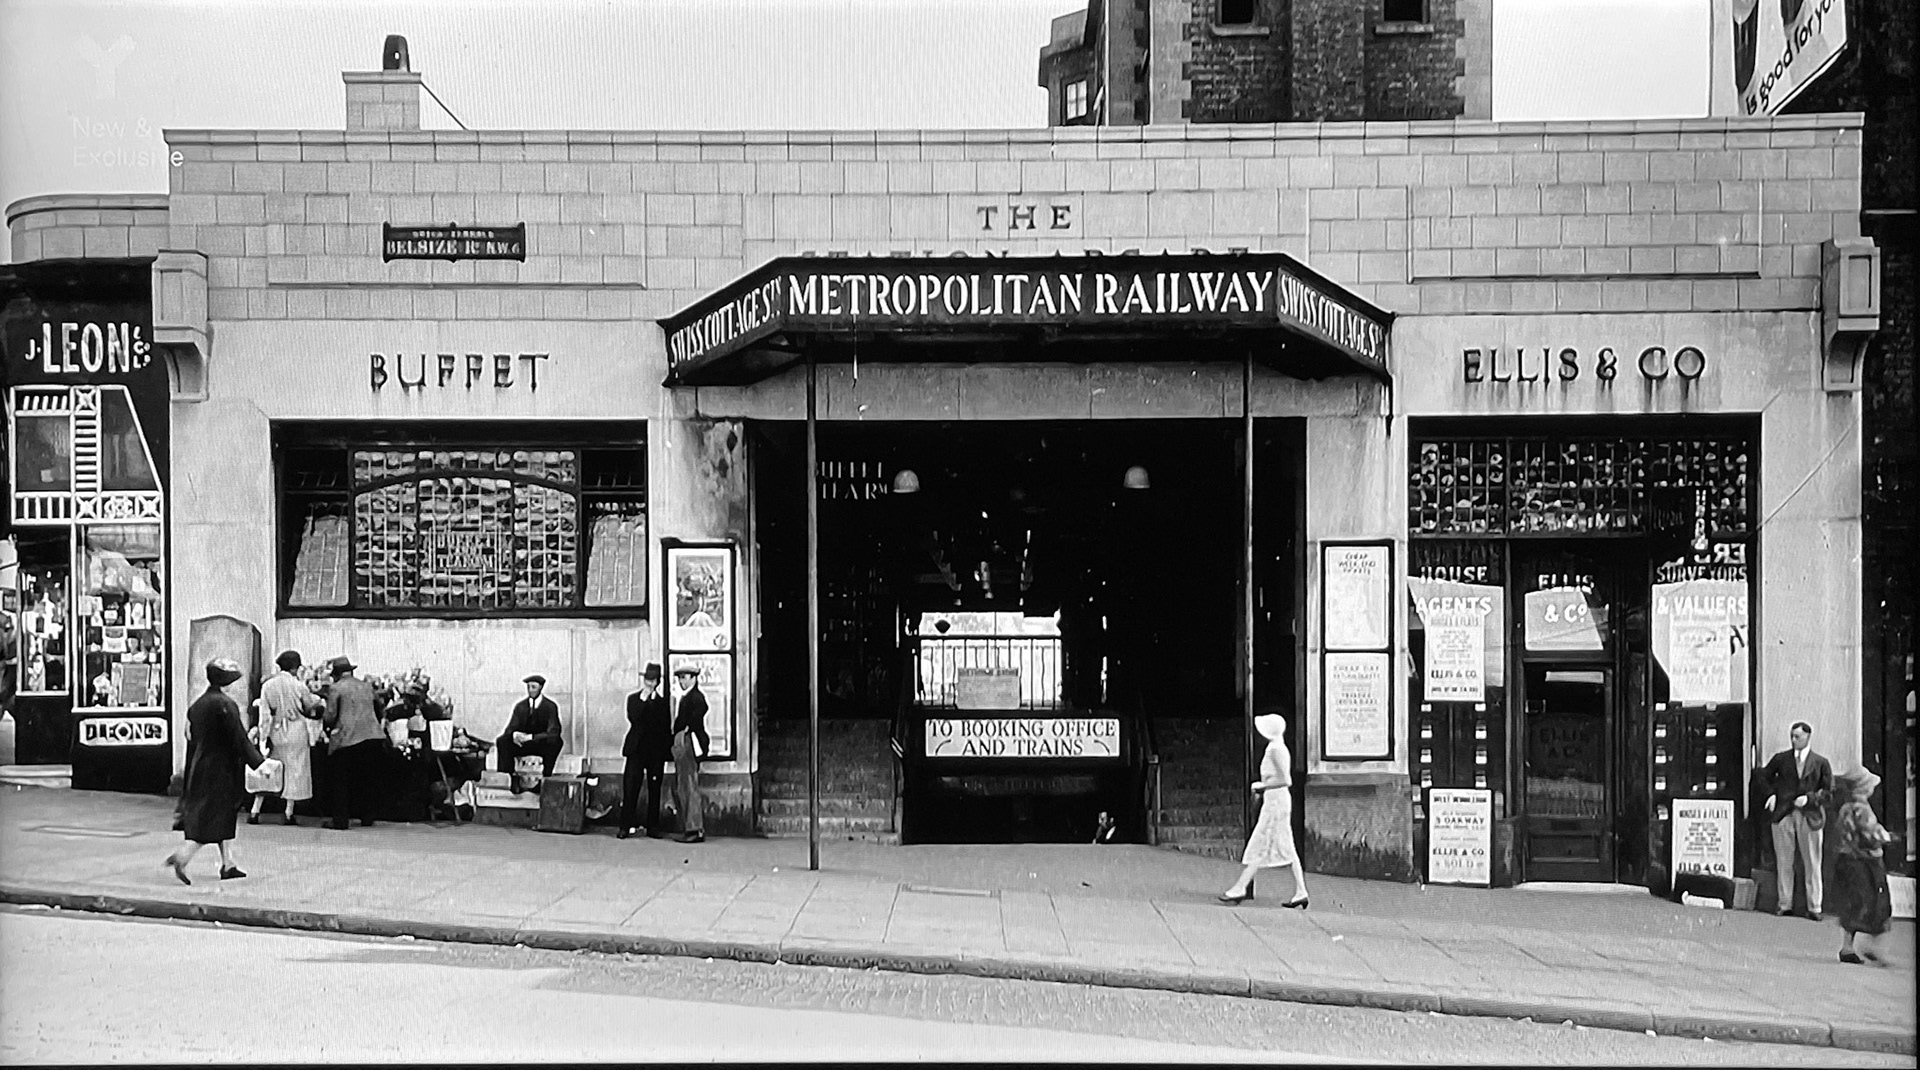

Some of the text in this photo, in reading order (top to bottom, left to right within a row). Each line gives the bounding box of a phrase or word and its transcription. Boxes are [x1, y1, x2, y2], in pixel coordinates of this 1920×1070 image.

[1760, 39, 1793, 113] good
[1794, 14, 1814, 54] for
[976, 205, 1071, 230] THE
[386, 240, 458, 255] BELSIZE
[788, 271, 1273, 316] METROPOLITAN RAILWAY
[1280, 274, 1317, 328] SWISS
[1318, 295, 1368, 356] COTTAGE
[670, 318, 704, 369] SWISS
[704, 287, 761, 351] COTTAGE
[42, 322, 130, 373] LEON
[370, 353, 550, 390] BUFFET
[1462, 346, 1706, 384] ELLIS & CO
[1420, 566, 1488, 584] HOUSE
[1538, 573, 1595, 594] ELLIS
[1656, 565, 1748, 584] SURVEYORS
[1415, 596, 1493, 618] AGENTS
[1544, 604, 1560, 623] &
[1656, 595, 1747, 617] & VALUERS
[928, 720, 1116, 738] TO BOOKING OFFICE
[962, 739, 1084, 756] AND TRAINS
